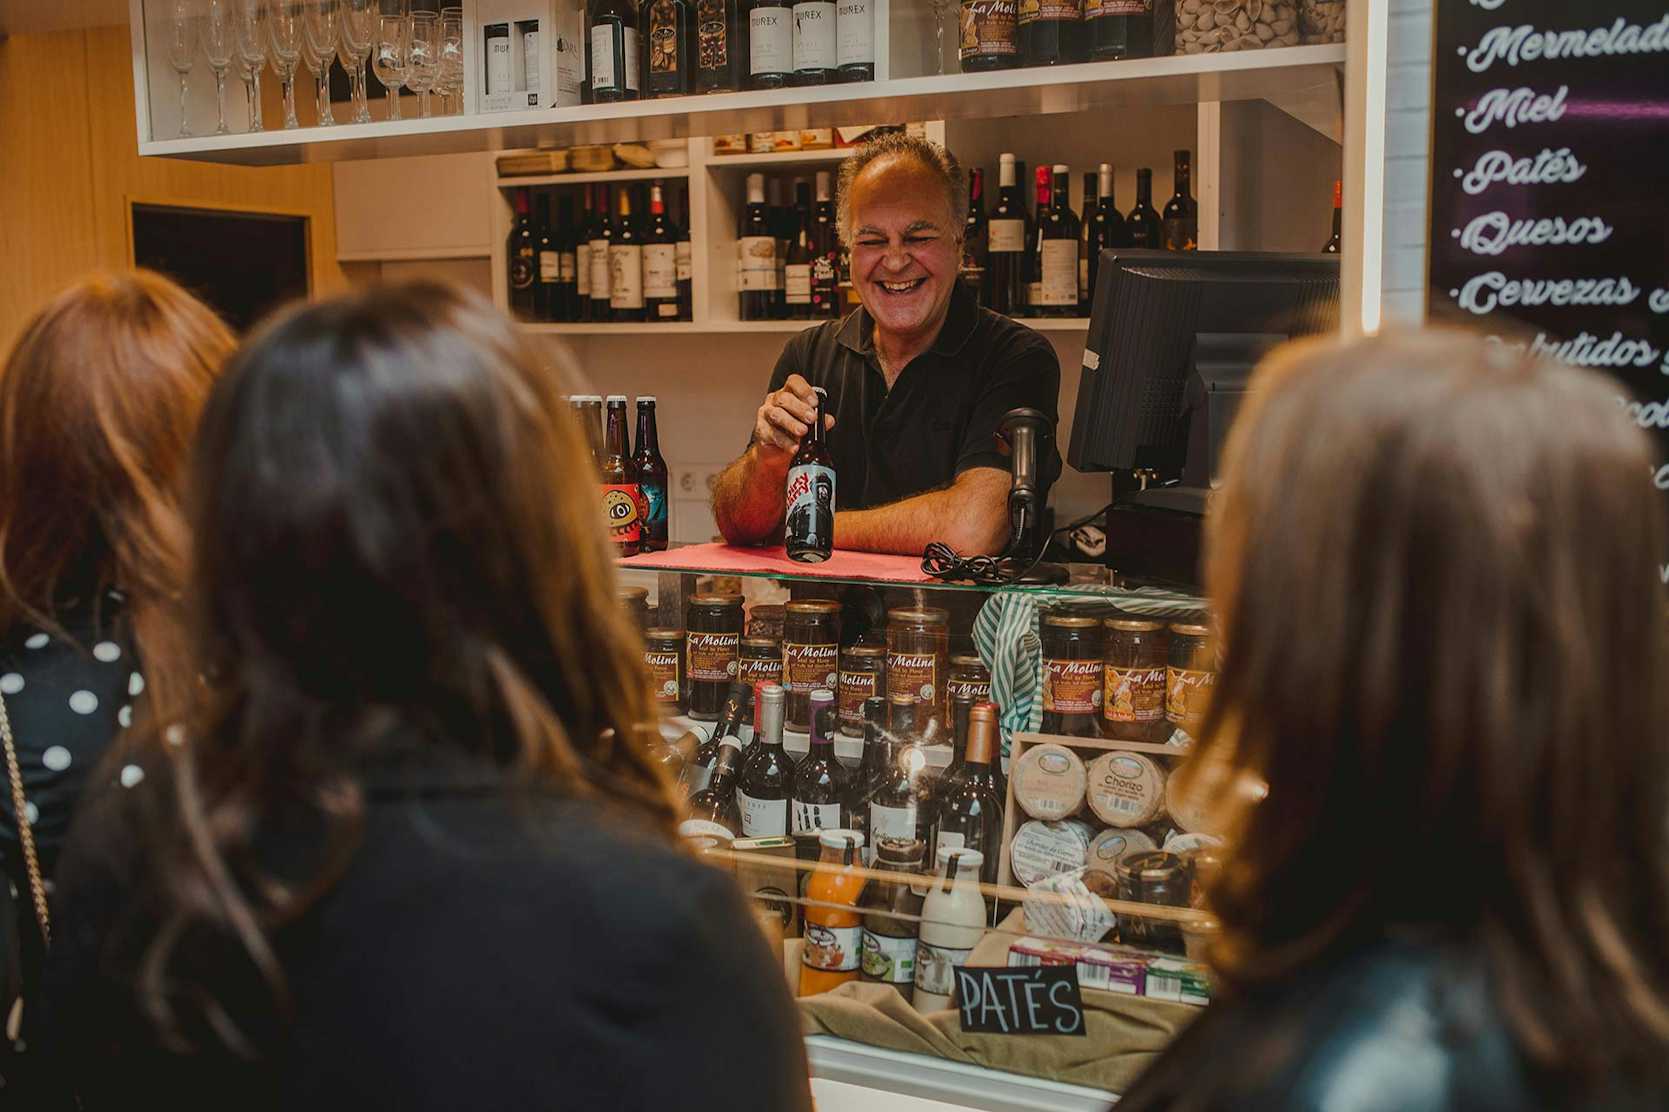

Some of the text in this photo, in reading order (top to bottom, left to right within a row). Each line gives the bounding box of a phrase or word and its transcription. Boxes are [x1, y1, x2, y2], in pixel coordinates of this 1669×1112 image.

[1464, 85, 1569, 134] Miel
[1462, 148, 1588, 195] Patés
[1460, 211, 1614, 255] Quesos
[1458, 272, 1641, 314] Cervezas
[1104, 775, 1144, 793] Chorizo
[958, 968, 1081, 1033] PATÉS
